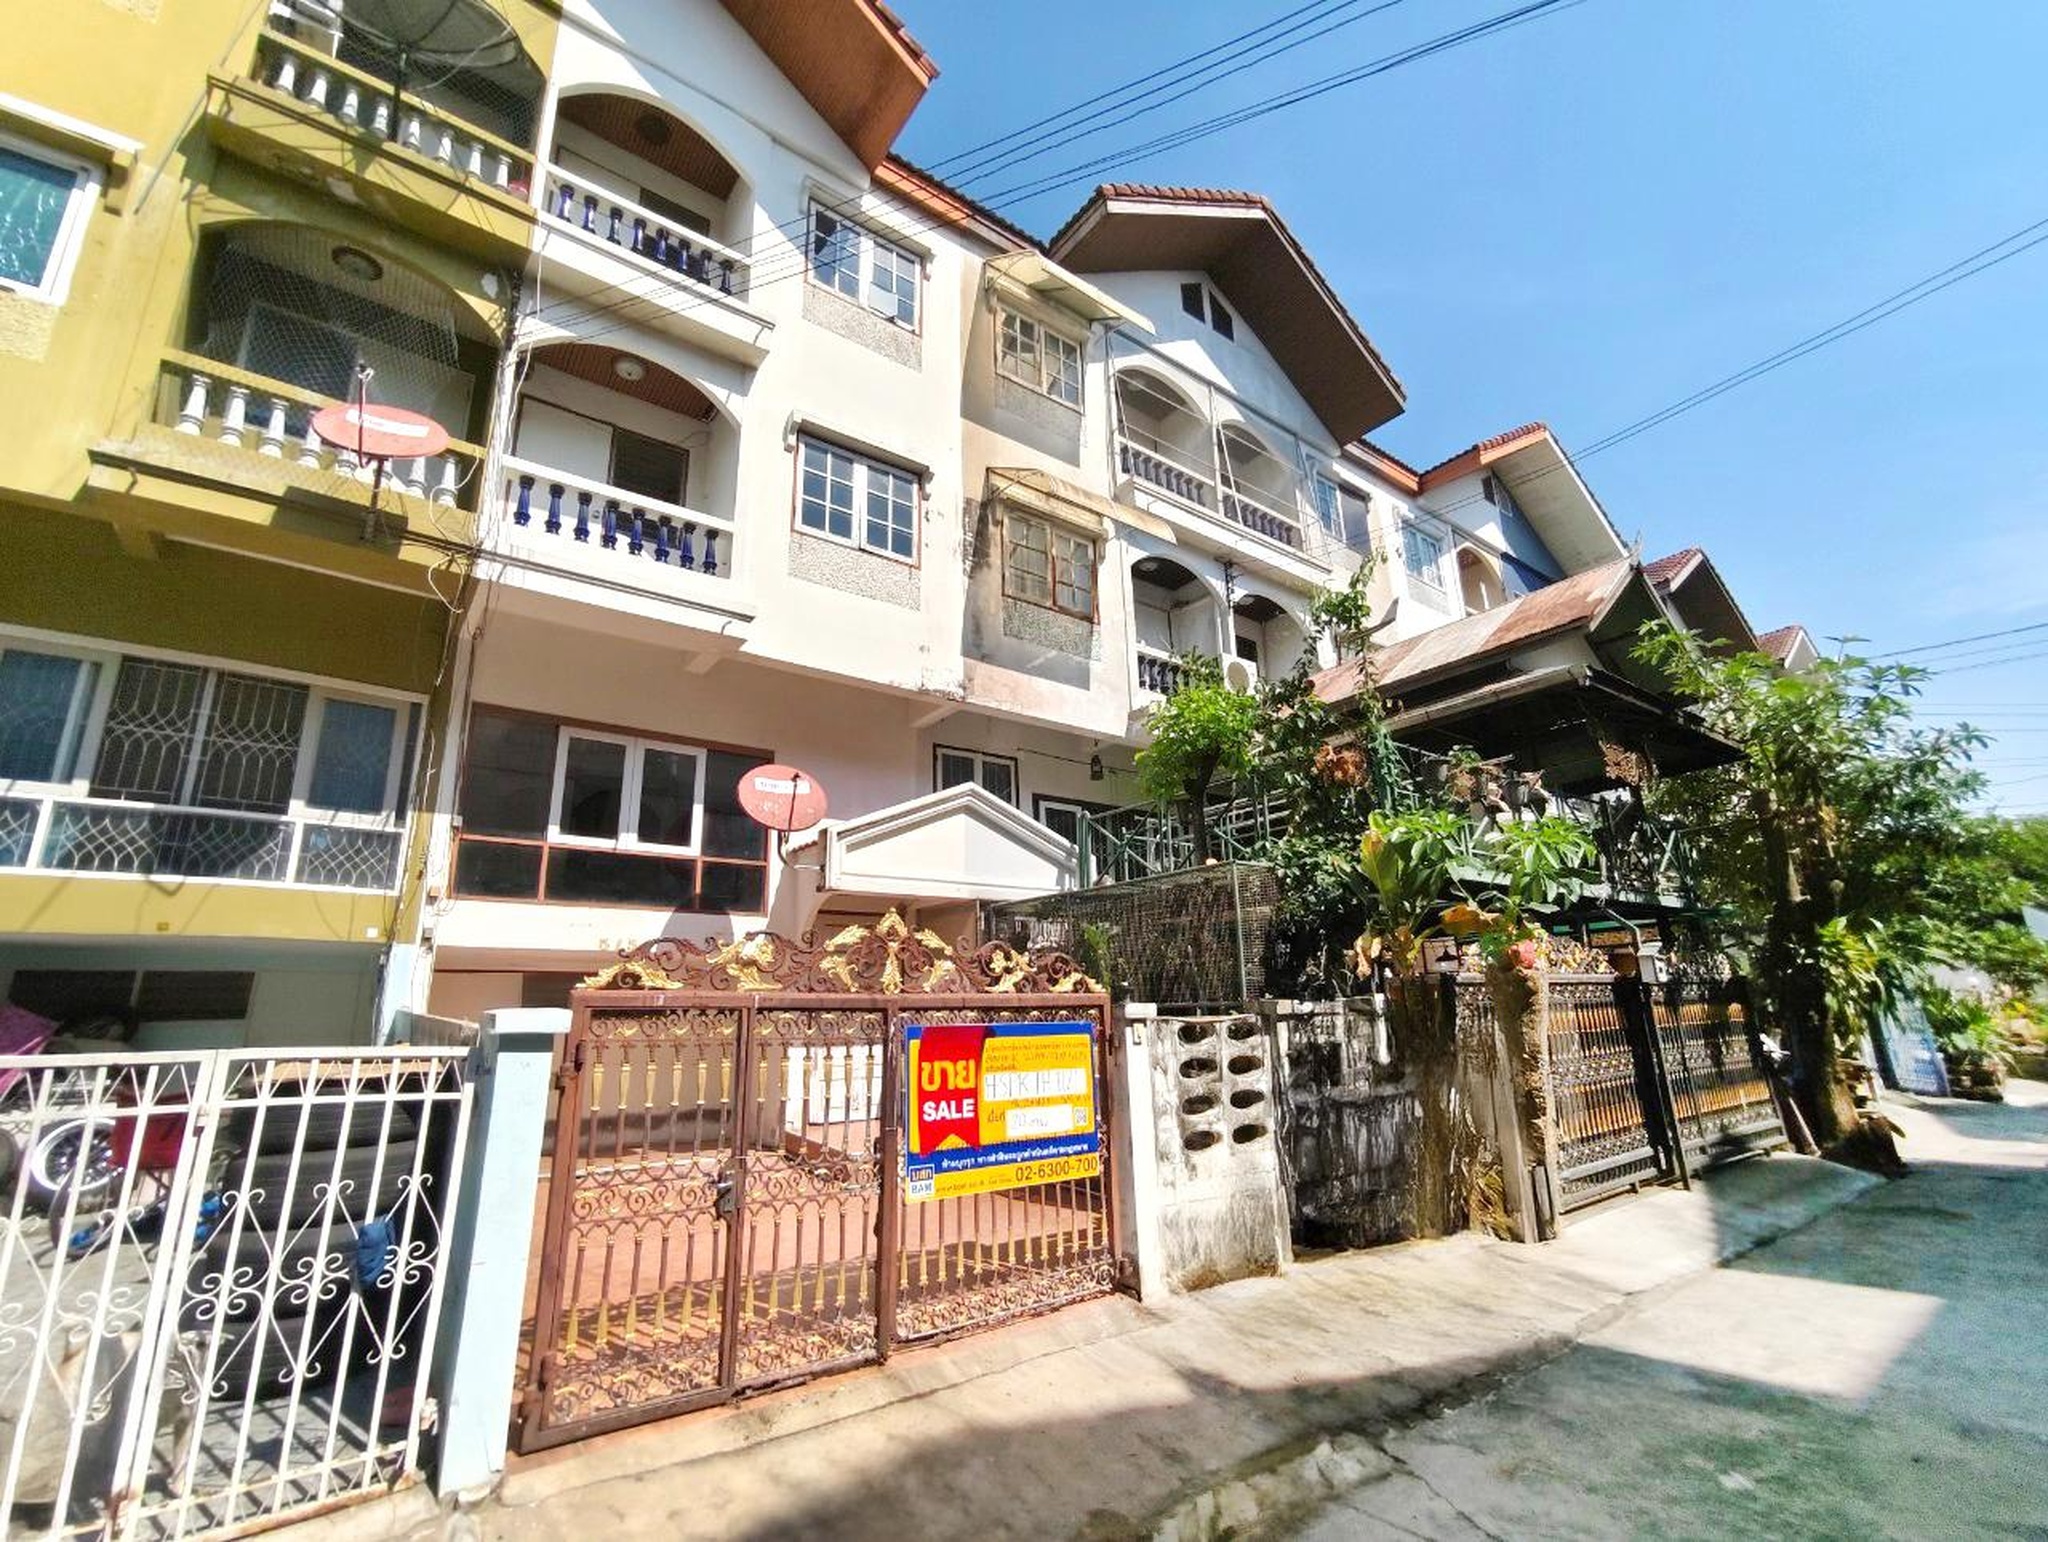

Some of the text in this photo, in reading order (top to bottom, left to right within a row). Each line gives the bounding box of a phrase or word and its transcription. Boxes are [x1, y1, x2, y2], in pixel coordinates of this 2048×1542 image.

[921, 1060, 976, 1092] ขาย
[923, 1098, 976, 1122] SALE
[1015, 1157, 1098, 1182] 02-6300-700
